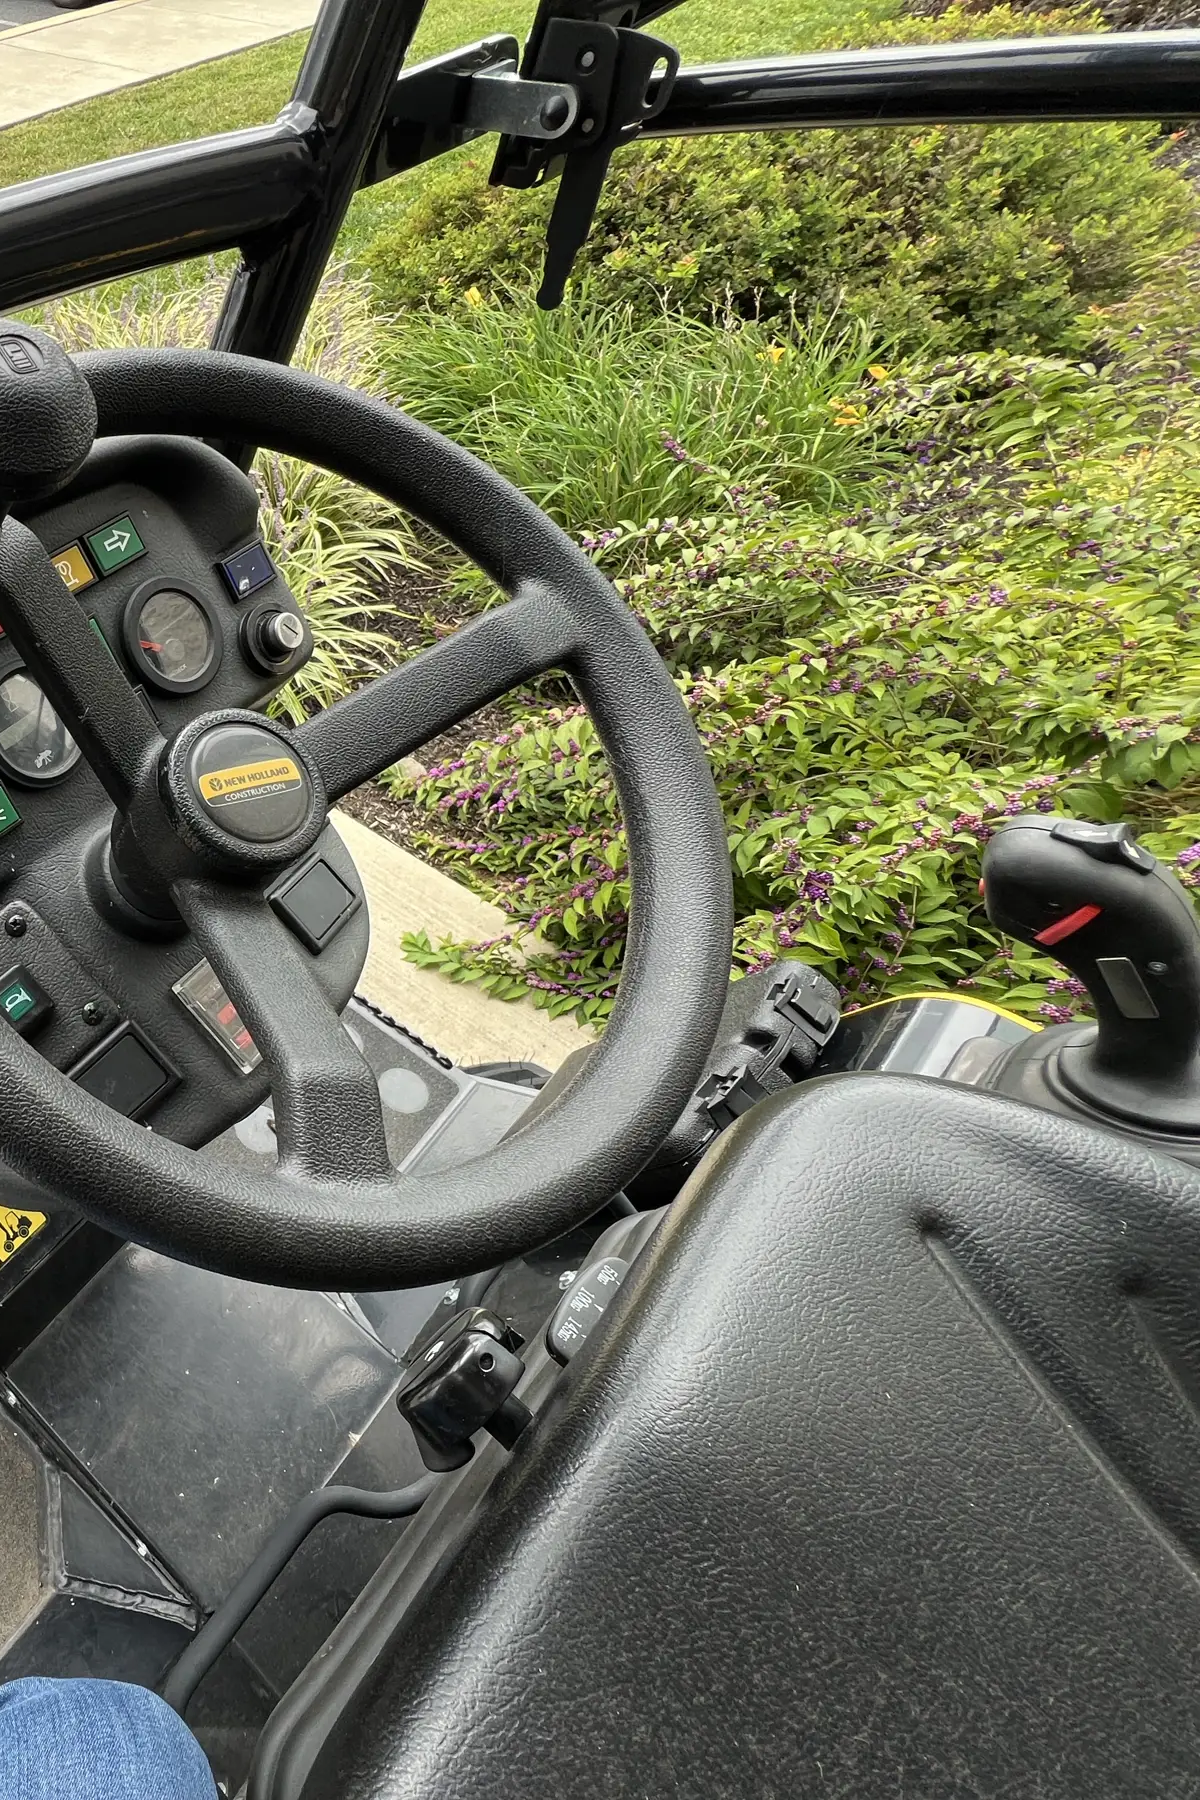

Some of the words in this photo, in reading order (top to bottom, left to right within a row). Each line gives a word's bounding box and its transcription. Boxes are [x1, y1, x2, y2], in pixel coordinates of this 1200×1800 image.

[224, 775, 246, 788] NEW
[247, 766, 290, 782] HOLLAND
[224, 782, 286, 801] CONSTRUCTION
